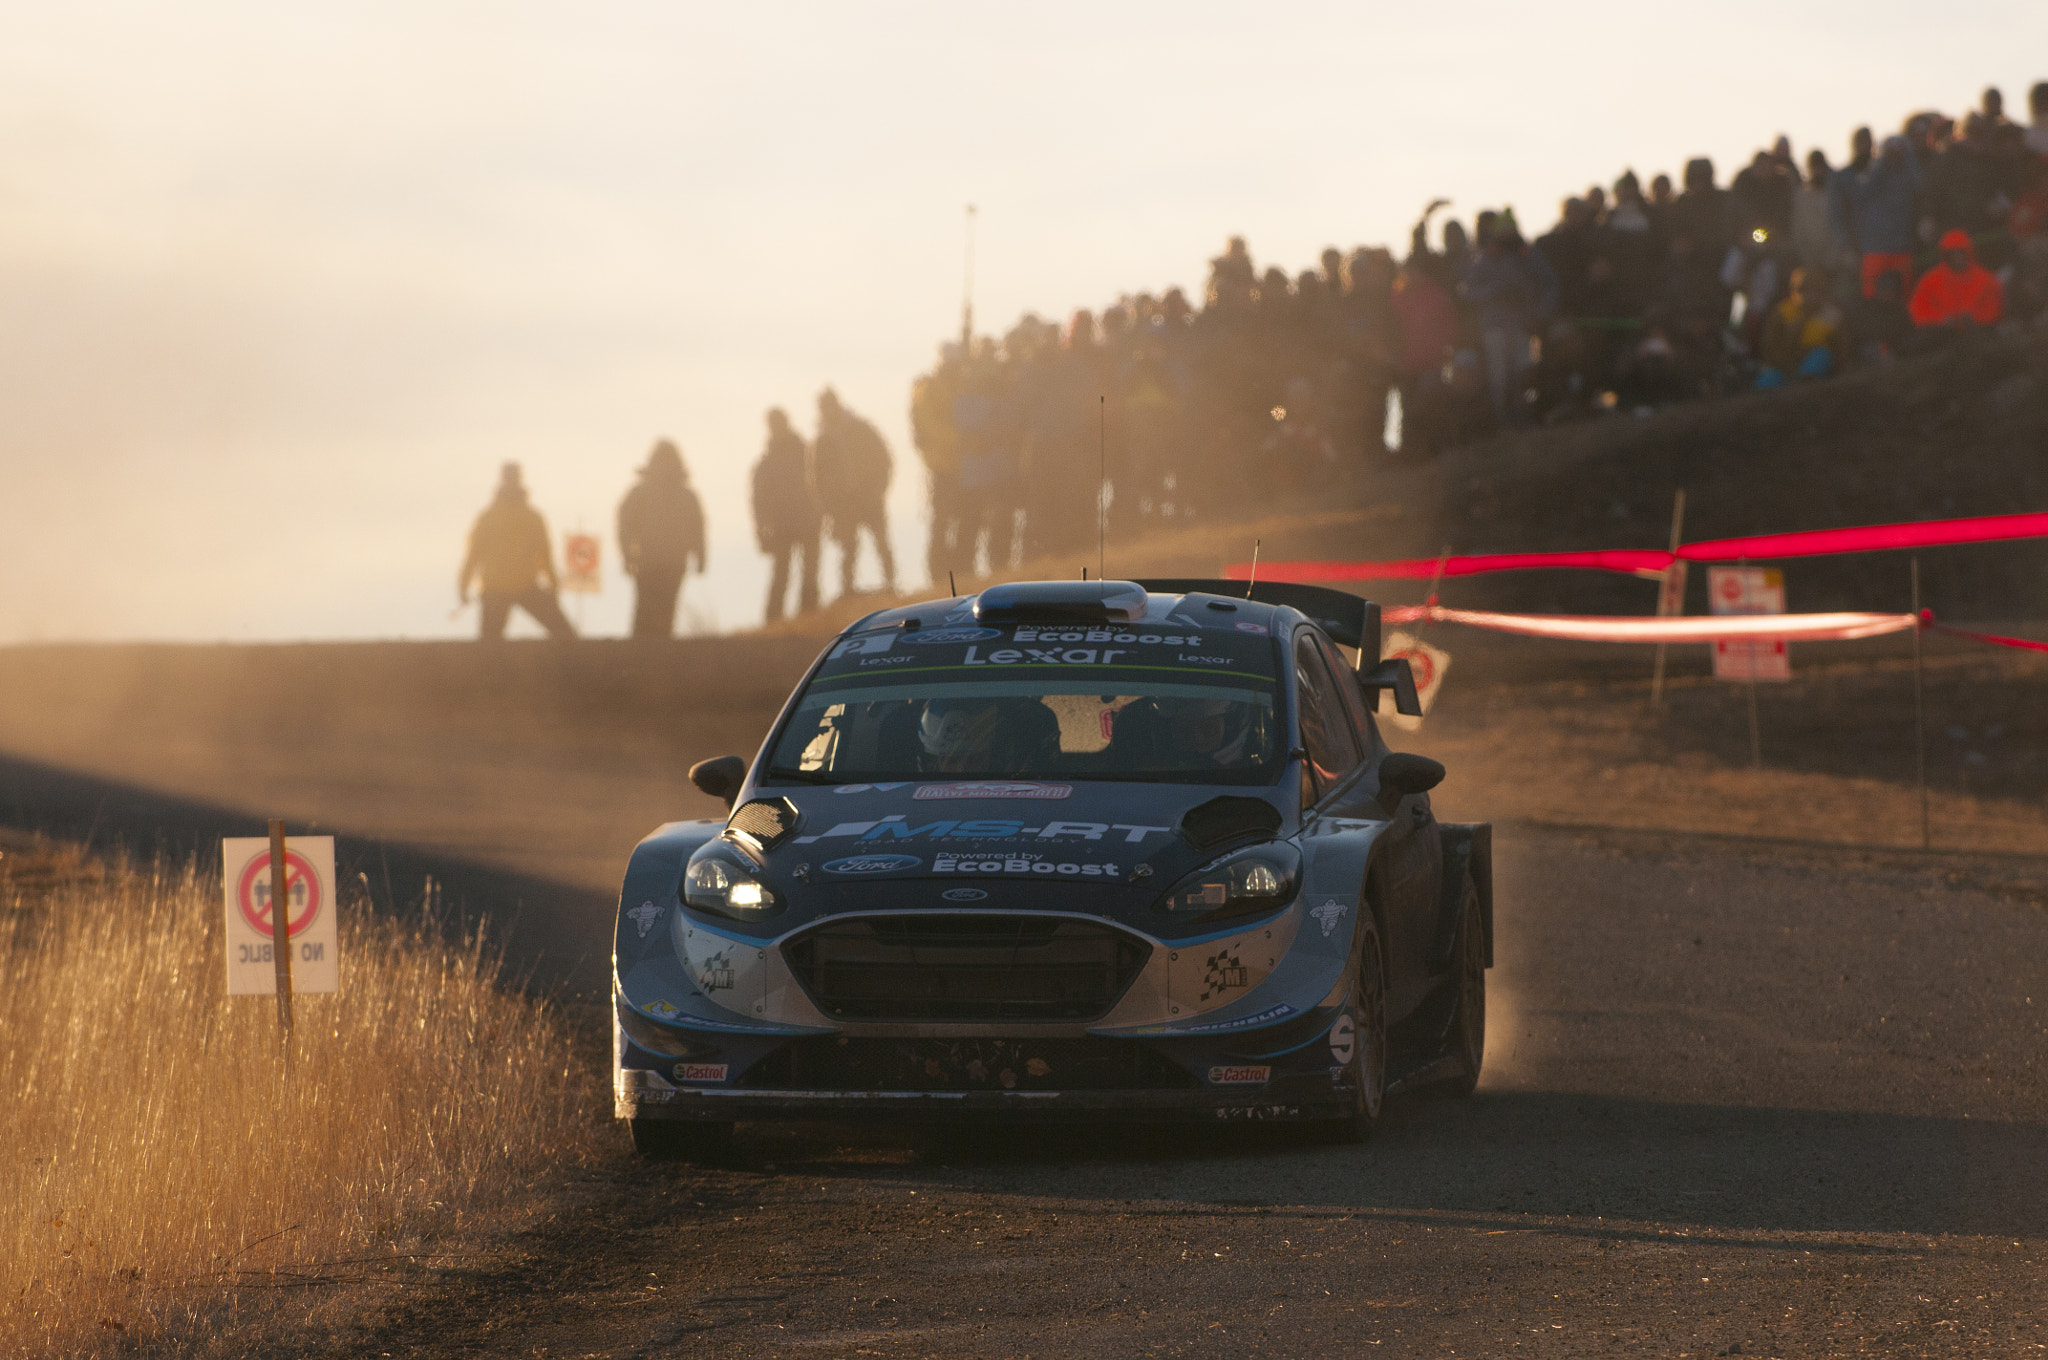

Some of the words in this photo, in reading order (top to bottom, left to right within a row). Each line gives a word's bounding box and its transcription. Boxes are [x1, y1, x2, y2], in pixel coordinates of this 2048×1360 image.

[1016, 624, 1101, 632] Powered
[1104, 624, 1128, 633] by
[1013, 630, 1203, 647] EcoBoost
[840, 638, 867, 657] 2
[963, 645, 1128, 665] Lexar
[859, 656, 916, 666] Lexar
[1178, 653, 1235, 665] Lexar
[861, 819, 1172, 843] MS-RT
[853, 837, 914, 847] ROAD
[936, 851, 1017, 861] Powered
[1020, 851, 1044, 862] by
[931, 859, 1120, 877] EcoBoost
[685, 1064, 725, 1080] Castrol
[1222, 1066, 1268, 1082] Castrol
